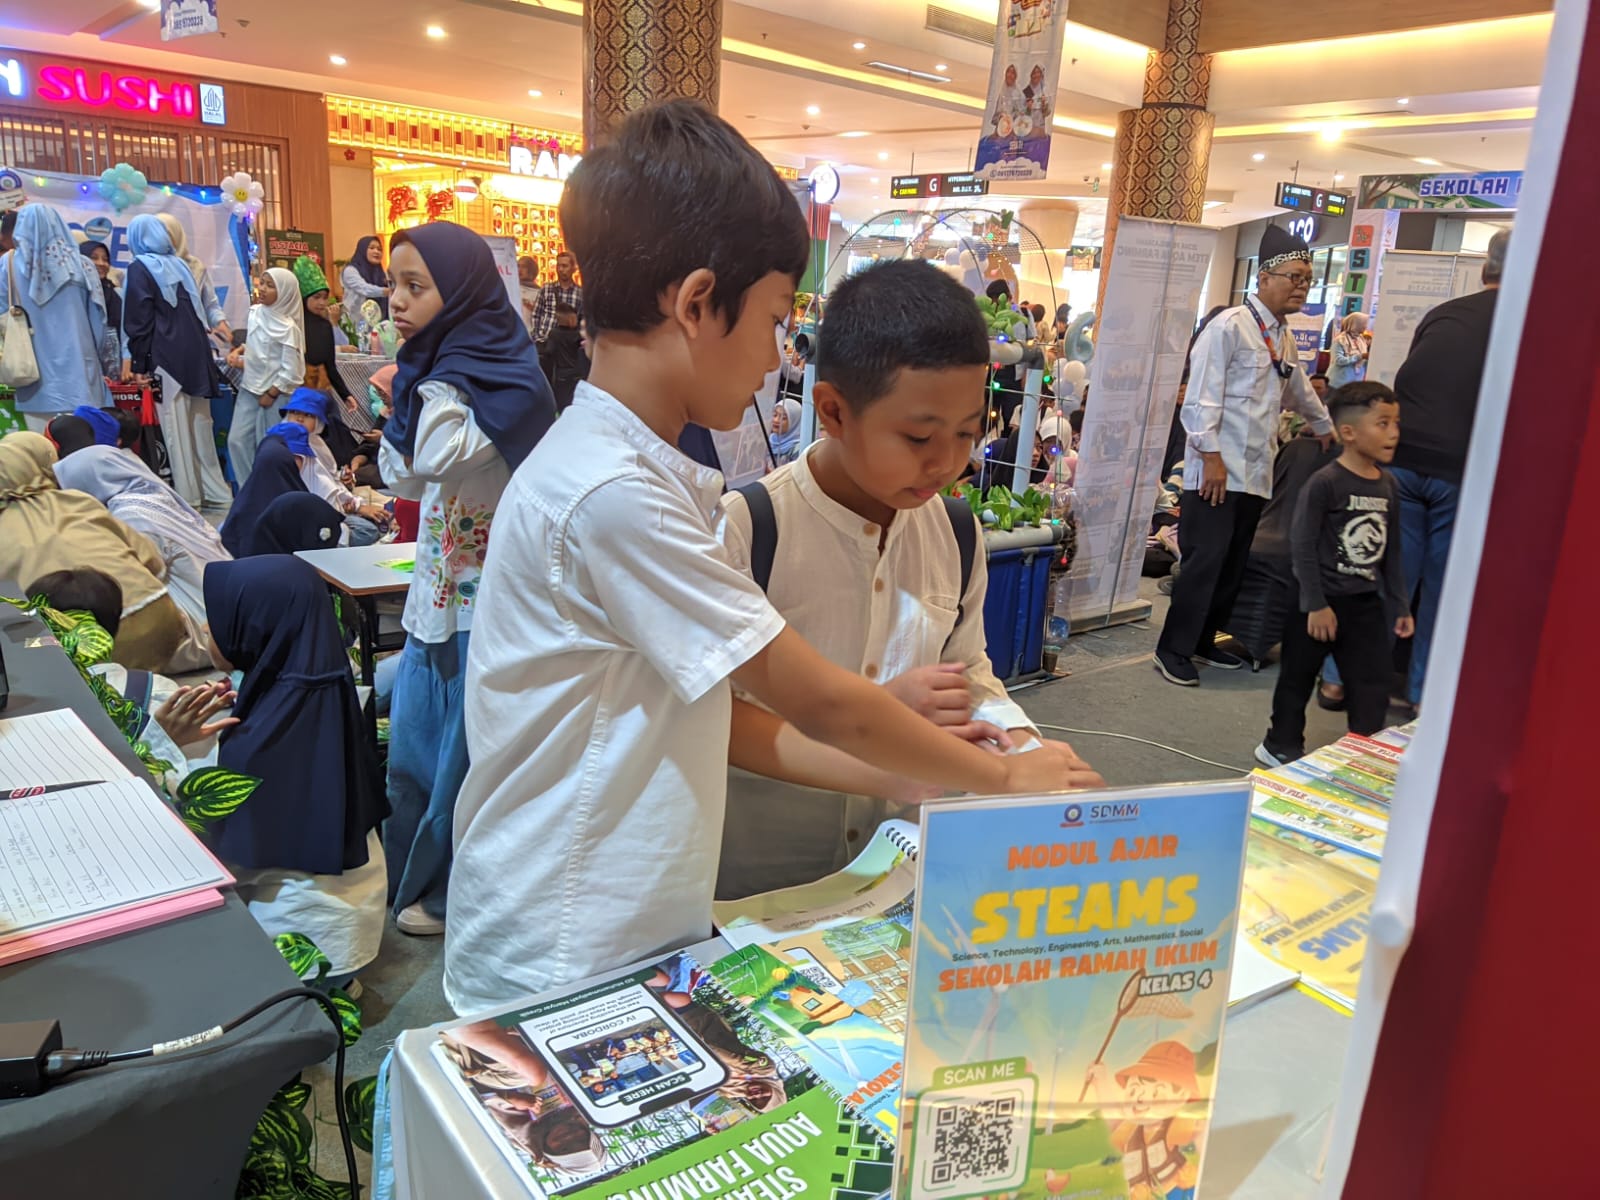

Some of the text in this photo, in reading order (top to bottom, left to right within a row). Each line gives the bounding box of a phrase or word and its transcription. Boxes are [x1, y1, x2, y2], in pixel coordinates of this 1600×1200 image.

[38, 66, 193, 115] SUSHI
[929, 178, 938, 192] G
[1420, 178, 1508, 196] SEKOLAH
[1316, 193, 1323, 208] G
[1090, 803, 1139, 818] SDMM
[1007, 835, 1179, 871] MODUL AJAR
[971, 874, 1199, 945] STEAMS
[1179, 928, 1203, 939] Social
[938, 940, 1218, 992] SEKOLAH RAMAH IKLIM
[1138, 968, 1213, 997] KELAS 4
[572, 1015, 637, 1040] IV CORDOBA
[943, 1061, 1016, 1085] SCAN ME
[624, 1074, 686, 1102] SCAN HERE
[607, 1112, 822, 1200] AQUA FARMIN
